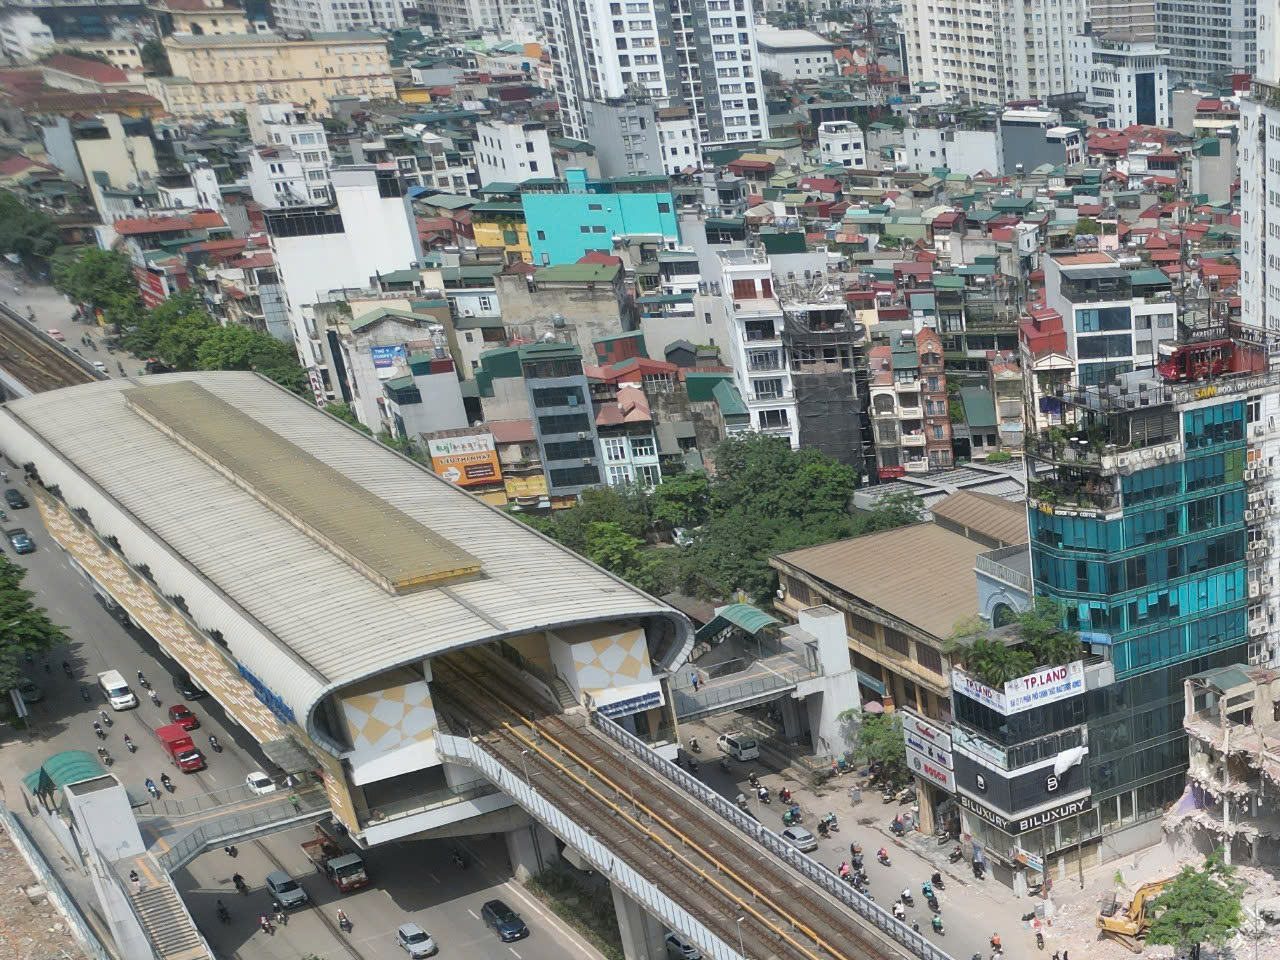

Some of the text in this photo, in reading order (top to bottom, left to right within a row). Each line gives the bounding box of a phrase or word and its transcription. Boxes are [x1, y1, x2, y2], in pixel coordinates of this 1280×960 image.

[1195, 385, 1217, 400] SAM
[1024, 668, 1067, 689] TP.LAND
[924, 763, 947, 785] BOSCH
[961, 796, 1007, 829] BILUXURY
[1020, 799, 1085, 831] BILUXURY
